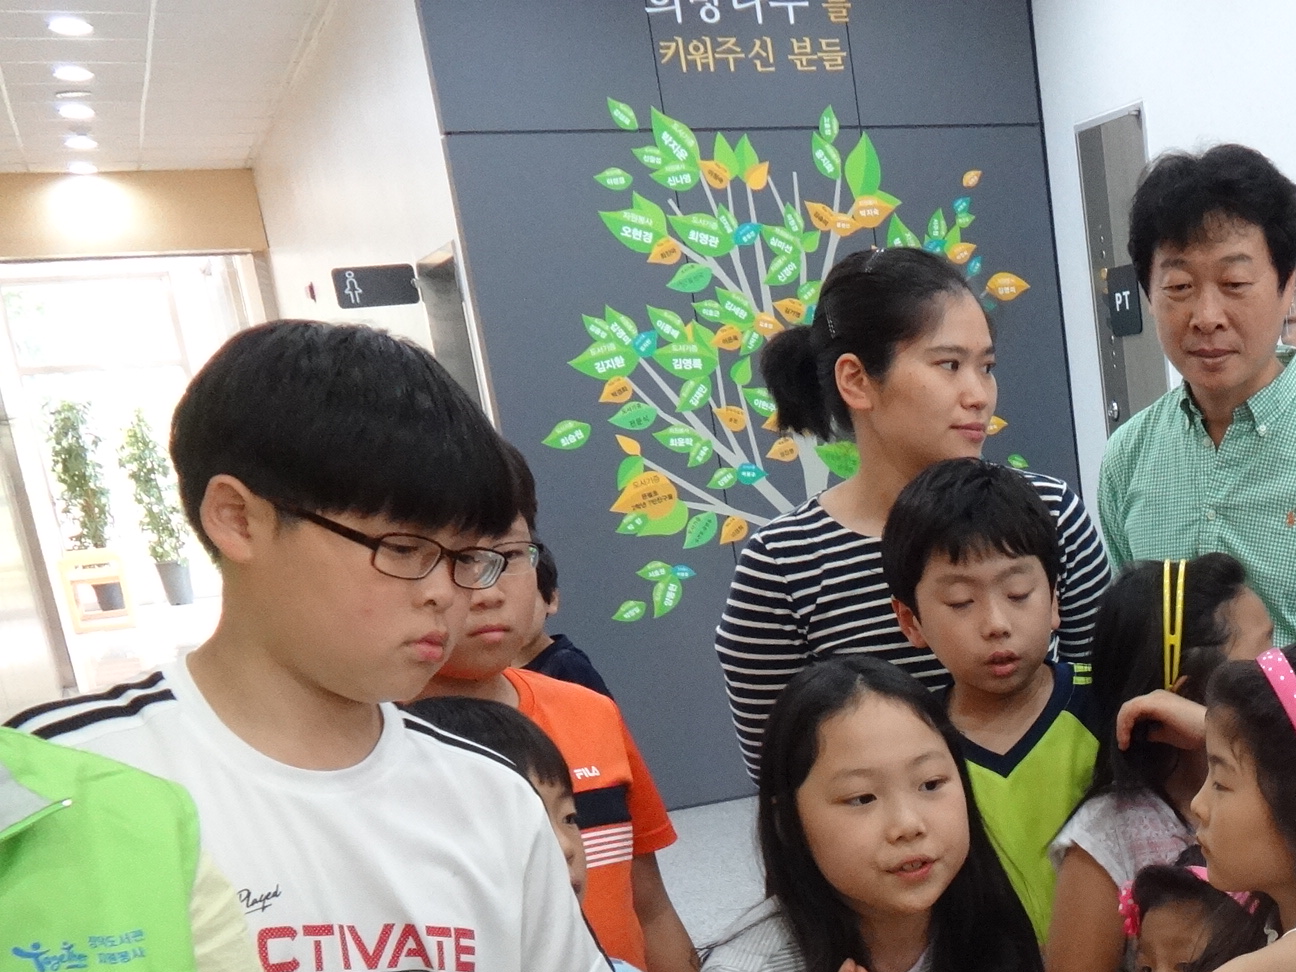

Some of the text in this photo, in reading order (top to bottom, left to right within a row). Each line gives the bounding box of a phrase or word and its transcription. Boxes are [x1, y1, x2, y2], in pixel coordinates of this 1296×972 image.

[659, 36, 847, 73] 키워주신 분들
[1115, 290, 1130, 311] PT
[633, 475, 660, 488] 도서기증
[574, 765, 600, 780] FILA
